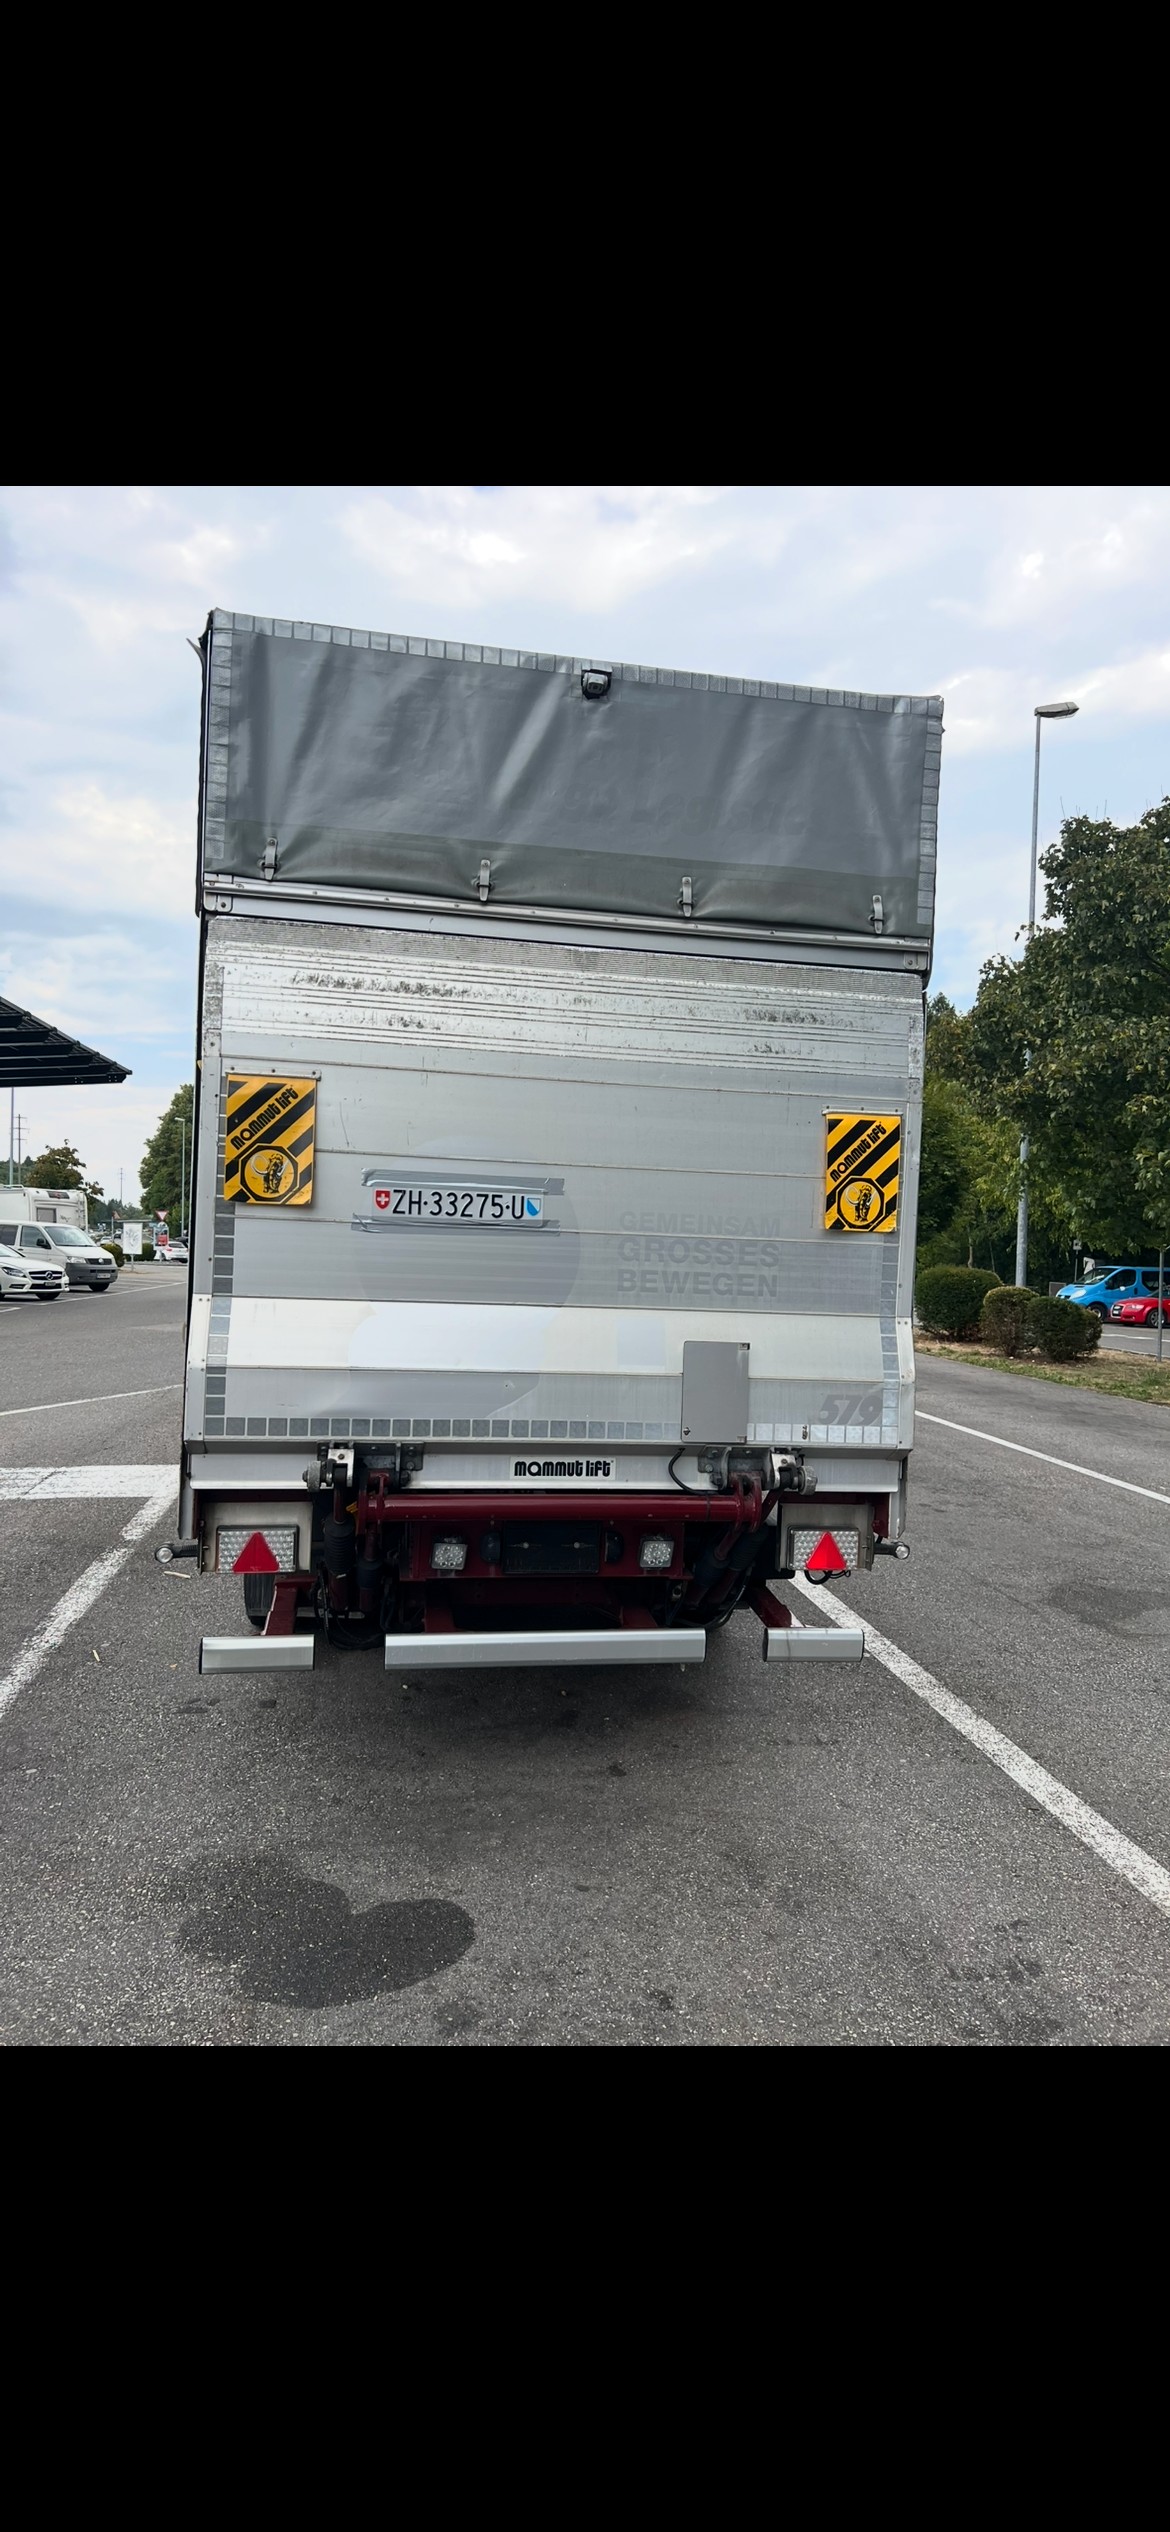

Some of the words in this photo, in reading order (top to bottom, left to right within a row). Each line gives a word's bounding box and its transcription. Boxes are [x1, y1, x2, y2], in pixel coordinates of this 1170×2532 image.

[230, 1102, 281, 1150] mammut
[274, 1087, 299, 1110] lift
[829, 1137, 872, 1182] mammut
[866, 1124, 887, 1144] lift
[619, 1210, 782, 1238] GEMEINSAM
[617, 1237, 781, 1268] GROSSES
[616, 1268, 778, 1298] BEWEGEN
[818, 1394, 883, 1425] 579
[514, 1460, 583, 1477] mammut
[585, 1460, 611, 1477] lift
